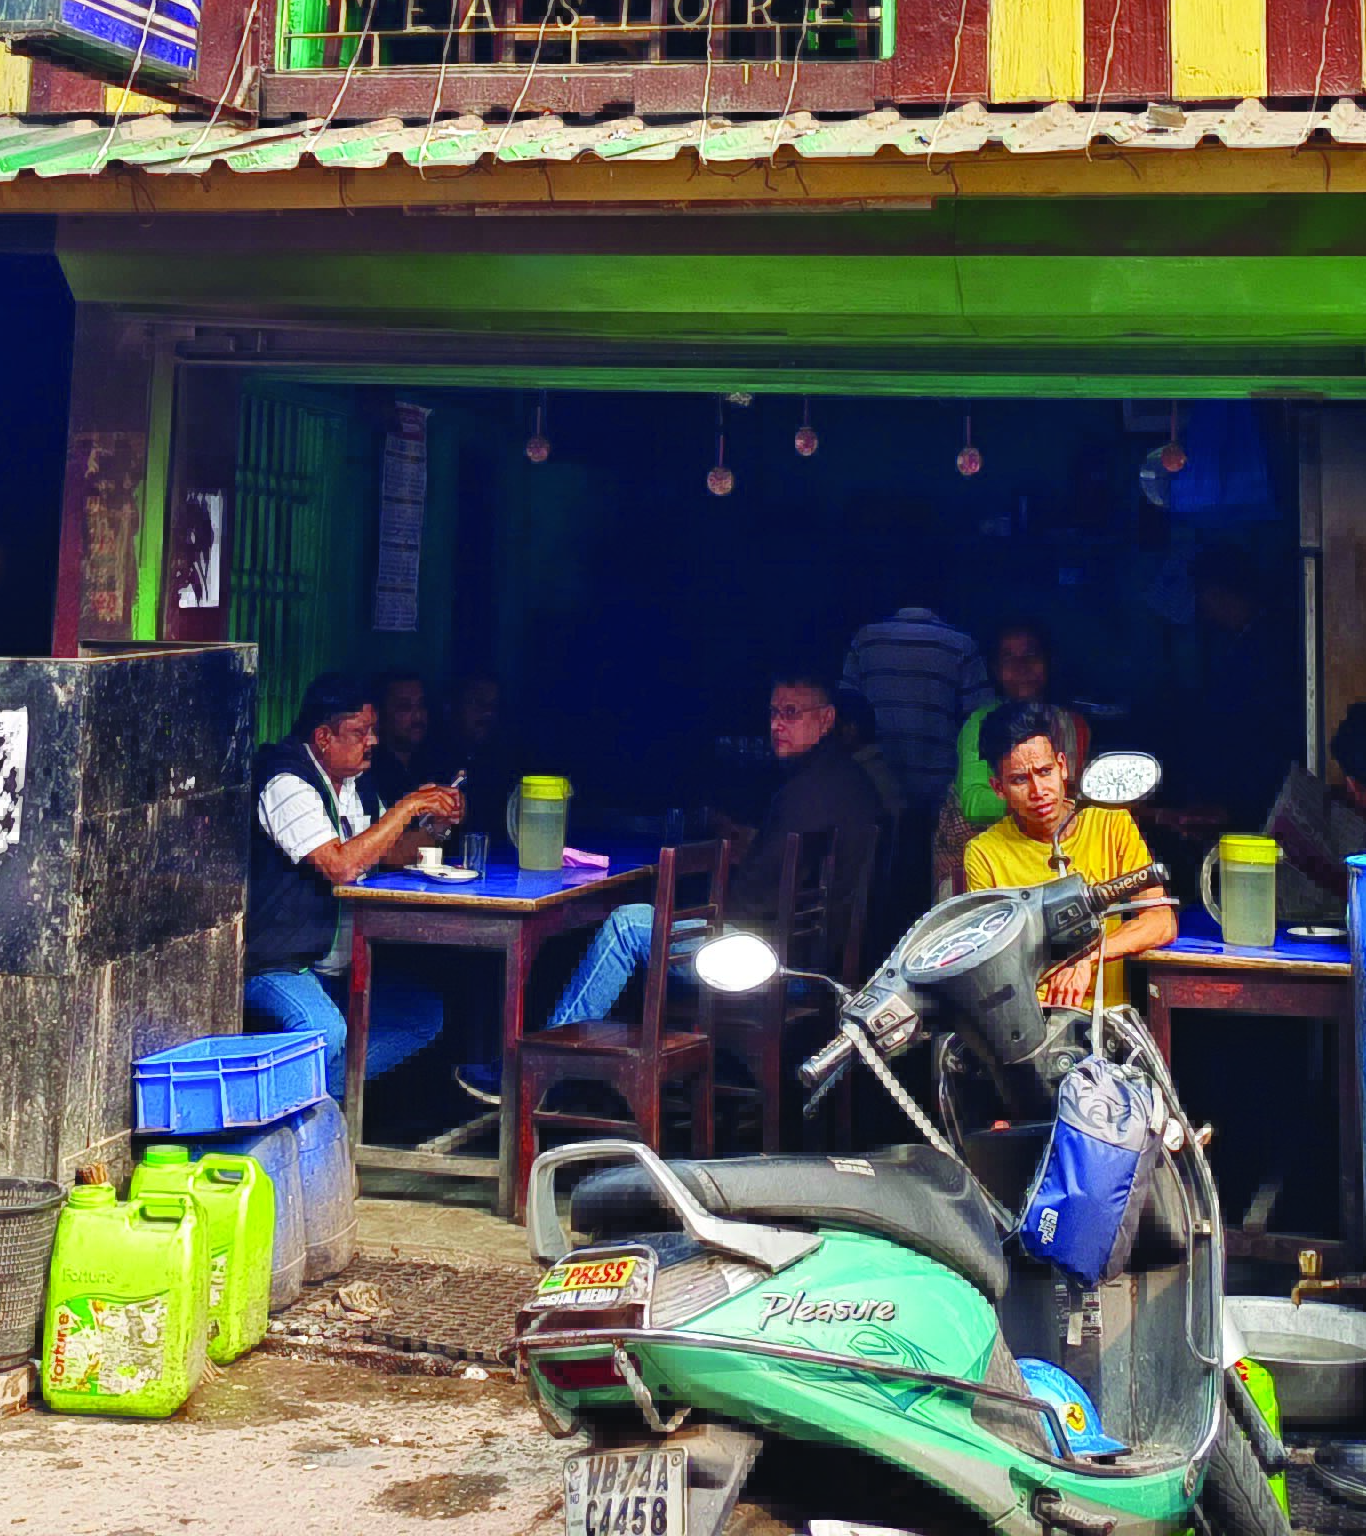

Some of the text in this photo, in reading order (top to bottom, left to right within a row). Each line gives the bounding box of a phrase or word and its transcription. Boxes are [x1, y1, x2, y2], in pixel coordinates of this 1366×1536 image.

[563, 1261, 629, 1288] PRESS
[758, 1291, 897, 1332] Pleasure
[50, 1313, 70, 1384] fortune
